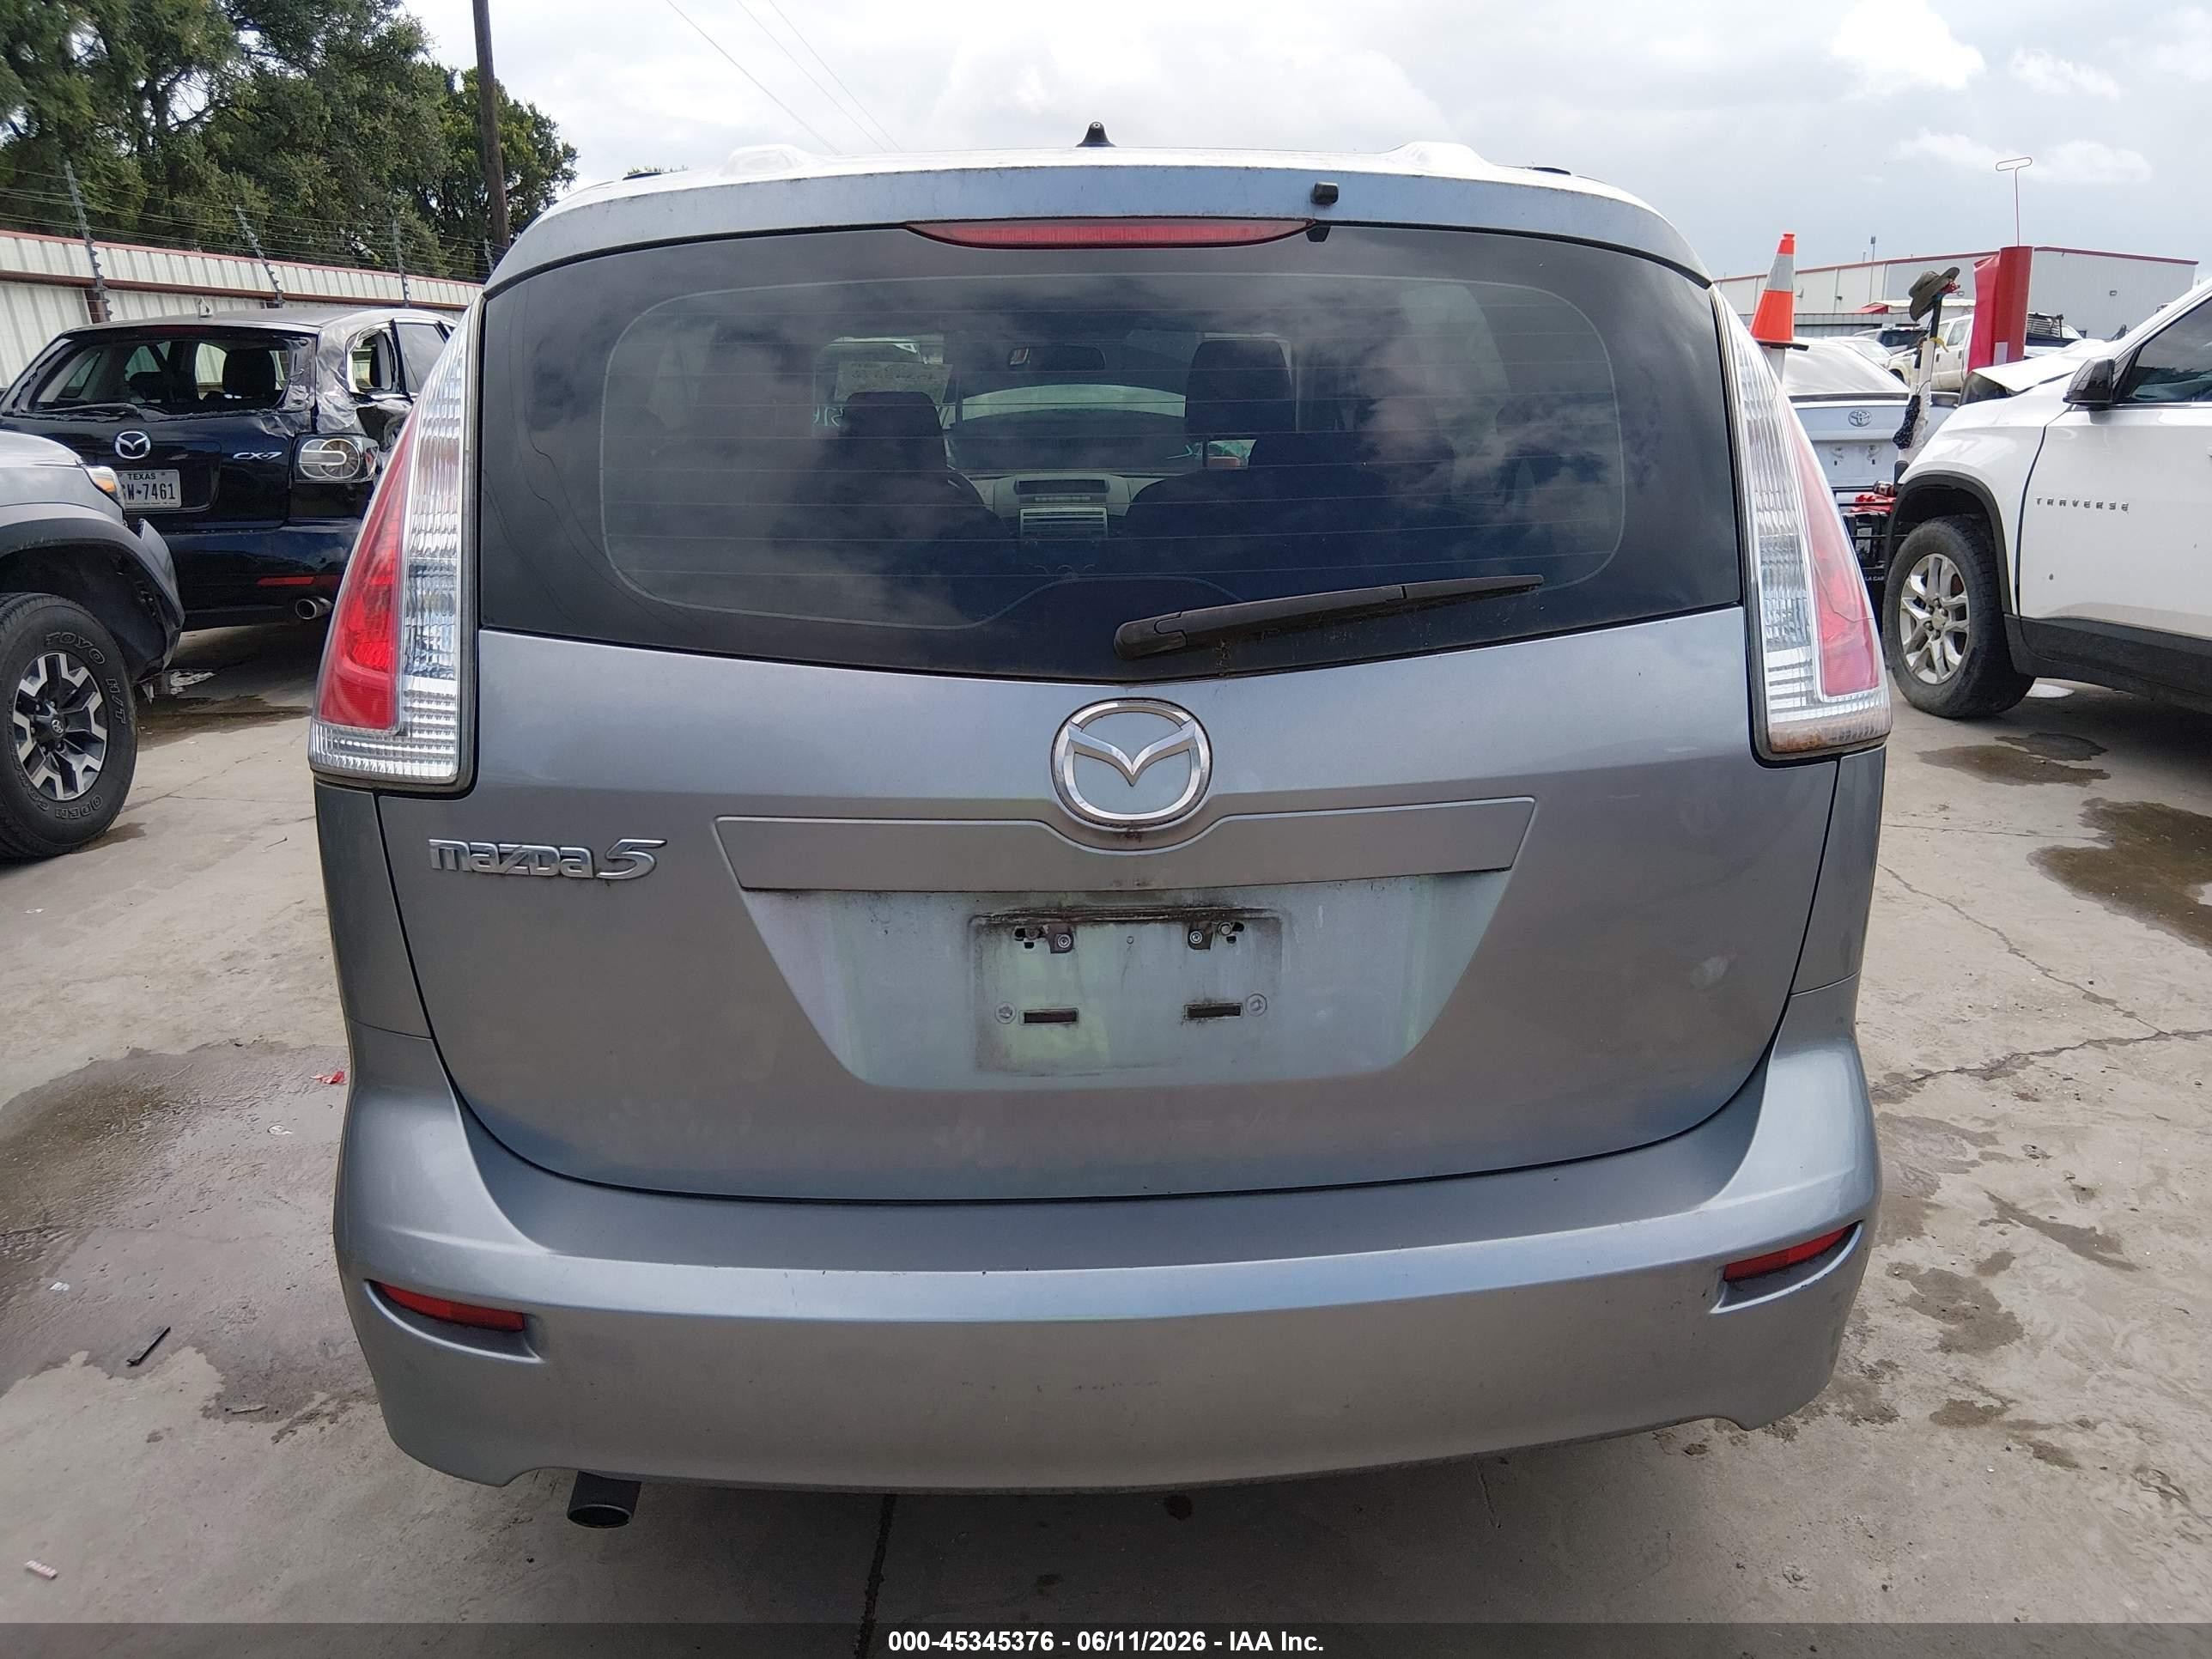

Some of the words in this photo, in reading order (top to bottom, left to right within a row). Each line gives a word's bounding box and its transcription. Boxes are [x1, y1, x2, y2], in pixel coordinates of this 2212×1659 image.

[233, 451, 283, 460] CX-7
[127, 472, 156, 481] TEXAS
[2036, 497, 2129, 512] TRAVERSE
[46, 631, 106, 665] TOYO
